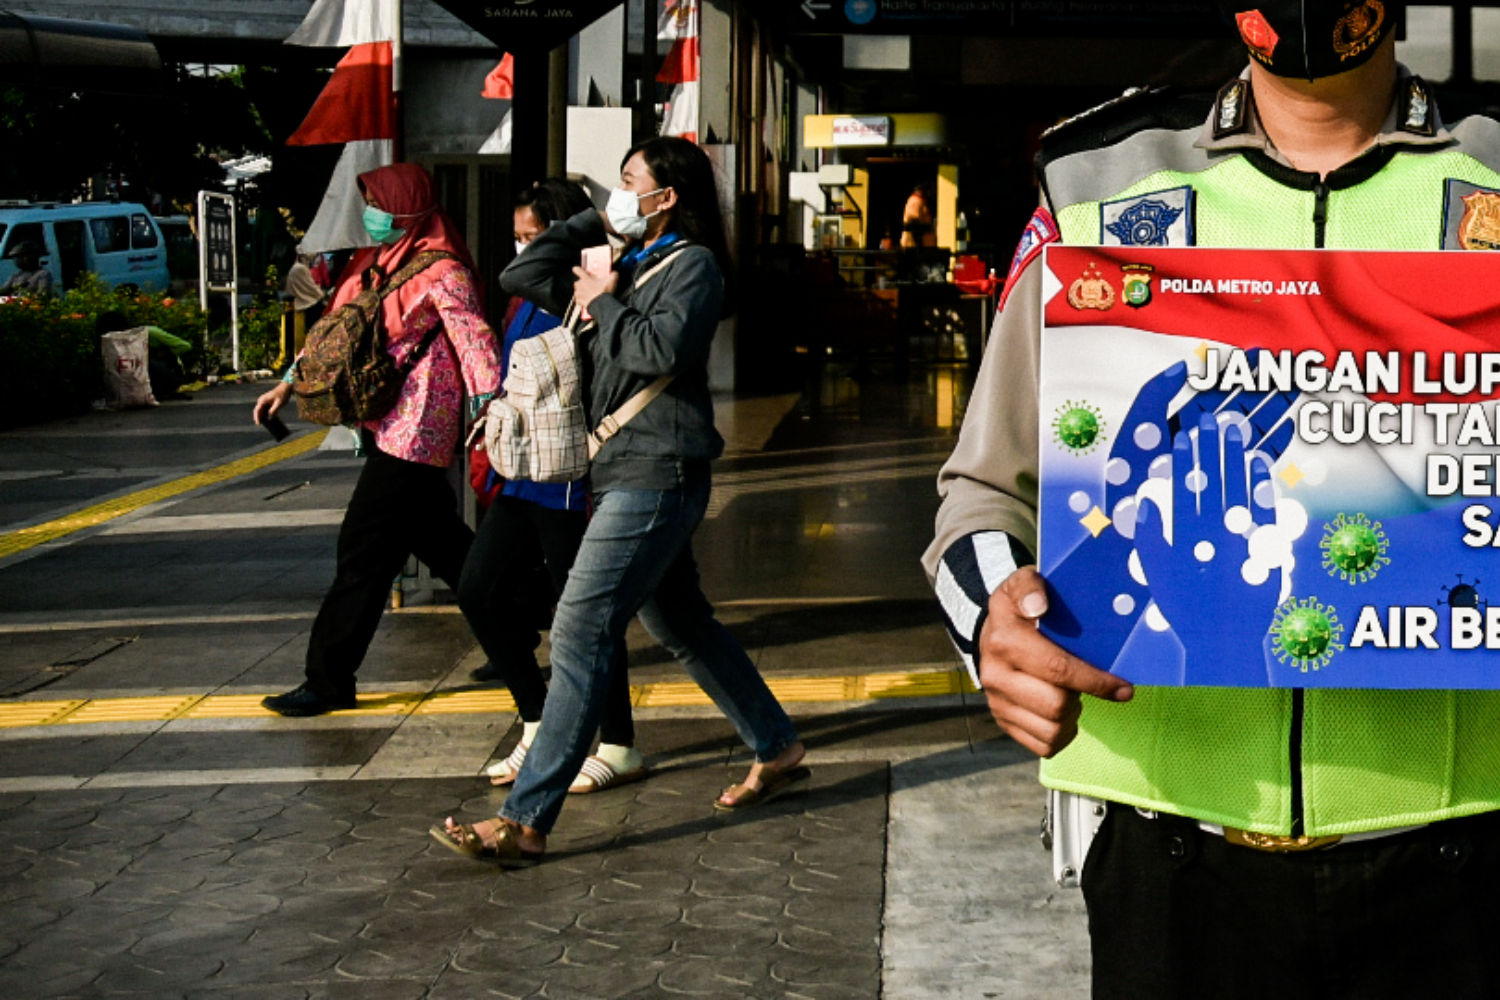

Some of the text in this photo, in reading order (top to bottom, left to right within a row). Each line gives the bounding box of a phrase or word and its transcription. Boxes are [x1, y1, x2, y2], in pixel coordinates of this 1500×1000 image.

[484, 7, 574, 18] SARANA JAYA
[1160, 278, 1320, 295] POLDA METRO JAYA
[1189, 349, 1402, 393] JANGAN
[1298, 402, 1413, 446] CUCI
[1350, 606, 1438, 649] AIR
